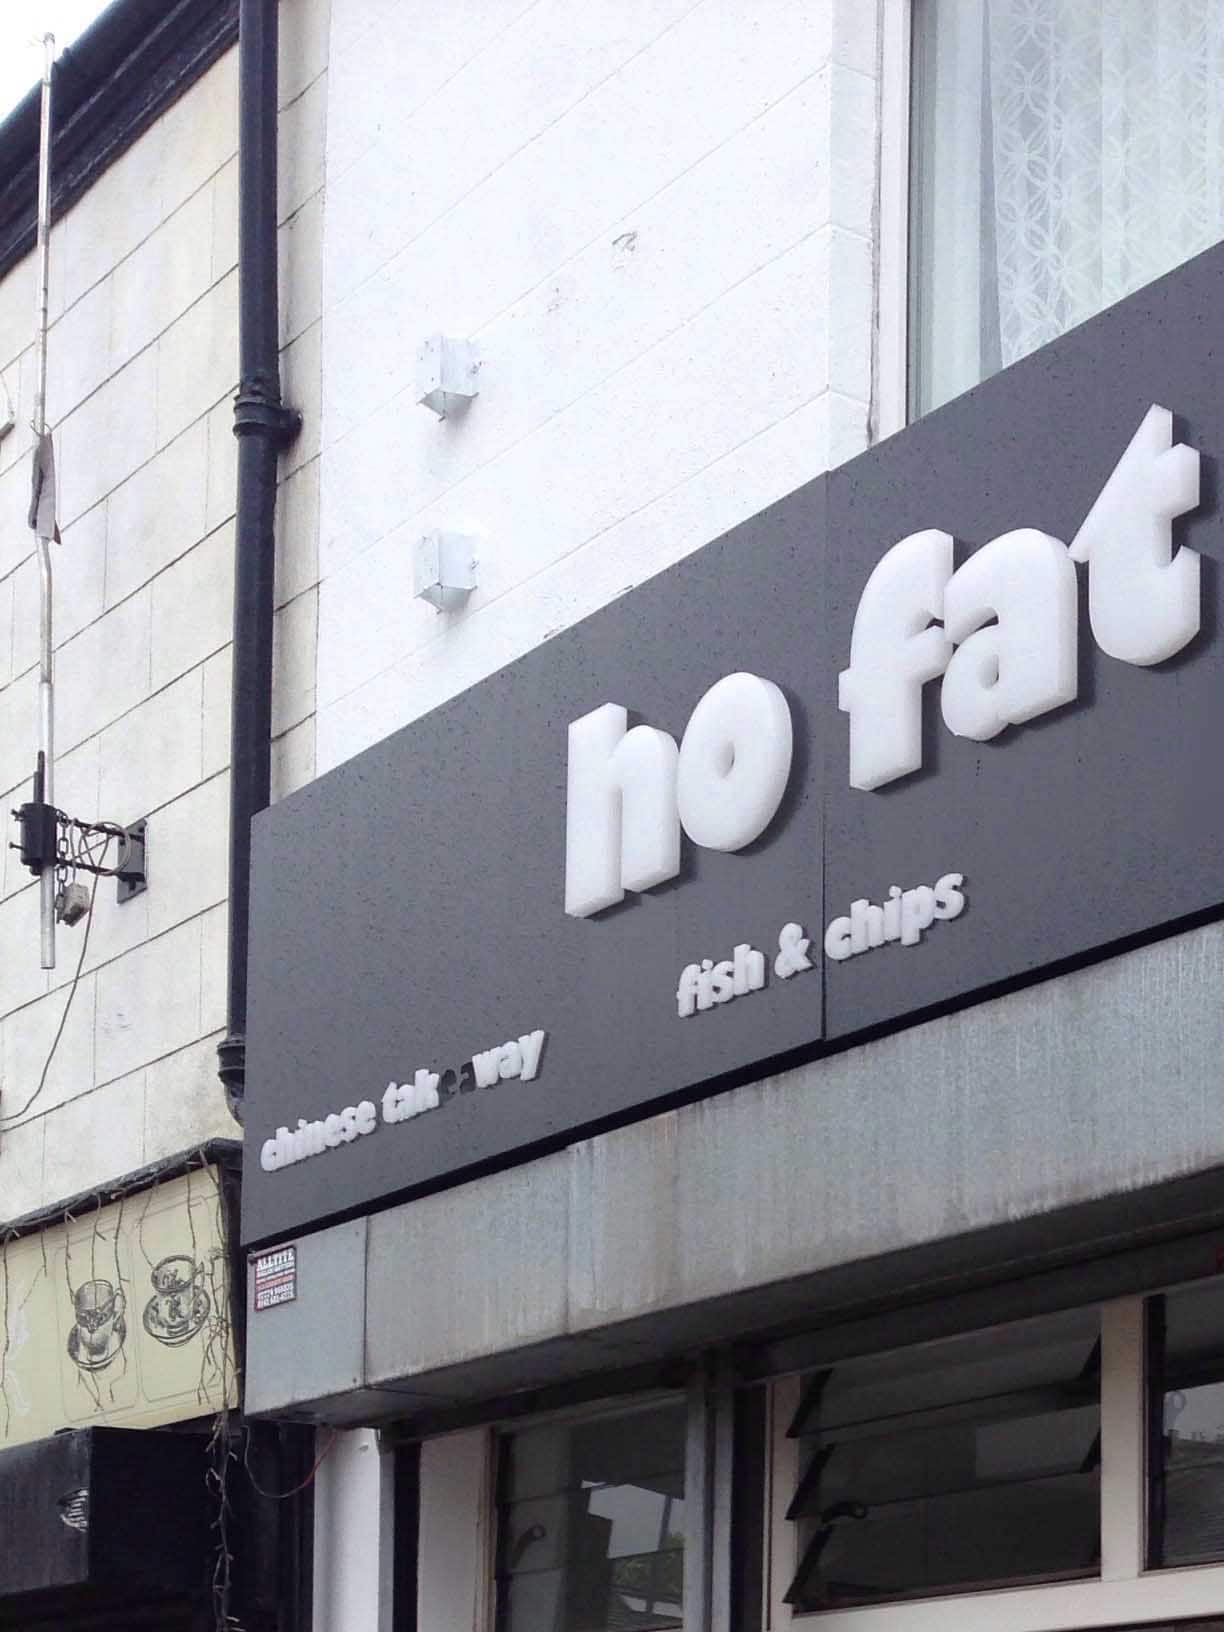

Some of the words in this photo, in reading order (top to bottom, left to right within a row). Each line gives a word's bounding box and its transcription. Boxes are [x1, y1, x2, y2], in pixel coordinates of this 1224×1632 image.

[838, 403, 1201, 792] fat
[677, 944, 766, 1017] fish
[774, 922, 813, 979] &
[825, 873, 965, 961] chips
[260, 1100, 377, 1172] chinese
